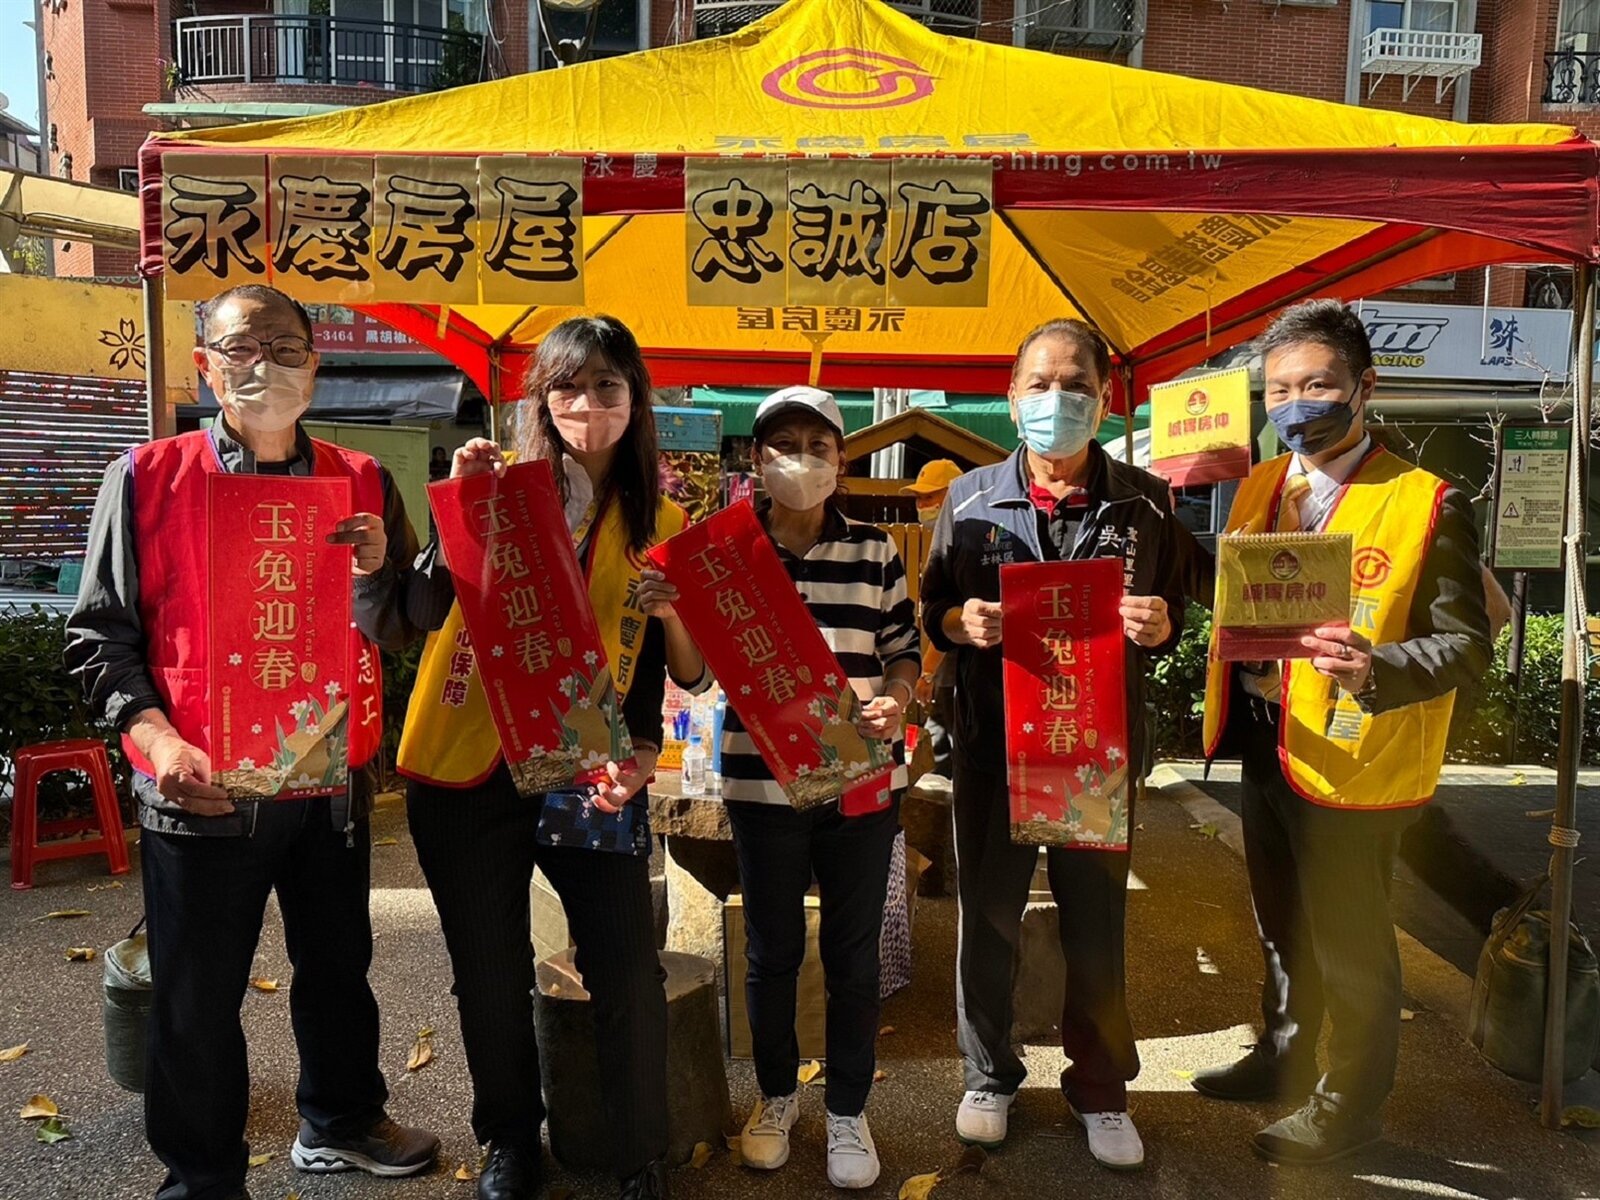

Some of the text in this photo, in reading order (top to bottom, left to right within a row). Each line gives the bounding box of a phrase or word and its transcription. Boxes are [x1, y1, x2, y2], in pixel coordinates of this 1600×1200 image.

[164, 173, 992, 285] 永慶房屋 忠誠店
[366, 329, 420, 345] 黑胡椒
[1371, 354, 1425, 367] ACING
[304, 505, 318, 546] Happy
[515, 489, 534, 528] Happy
[305, 552, 316, 591] Lunar
[473, 494, 553, 675] 玉兔迎春
[253, 501, 297, 690] 玉兔迎春
[305, 596, 316, 622] New
[305, 628, 316, 658] Year
[689, 543, 796, 704] 玉兔迎春
[358, 648, 378, 726] 志工
[1038, 582, 1079, 755] 玉兔迎春
